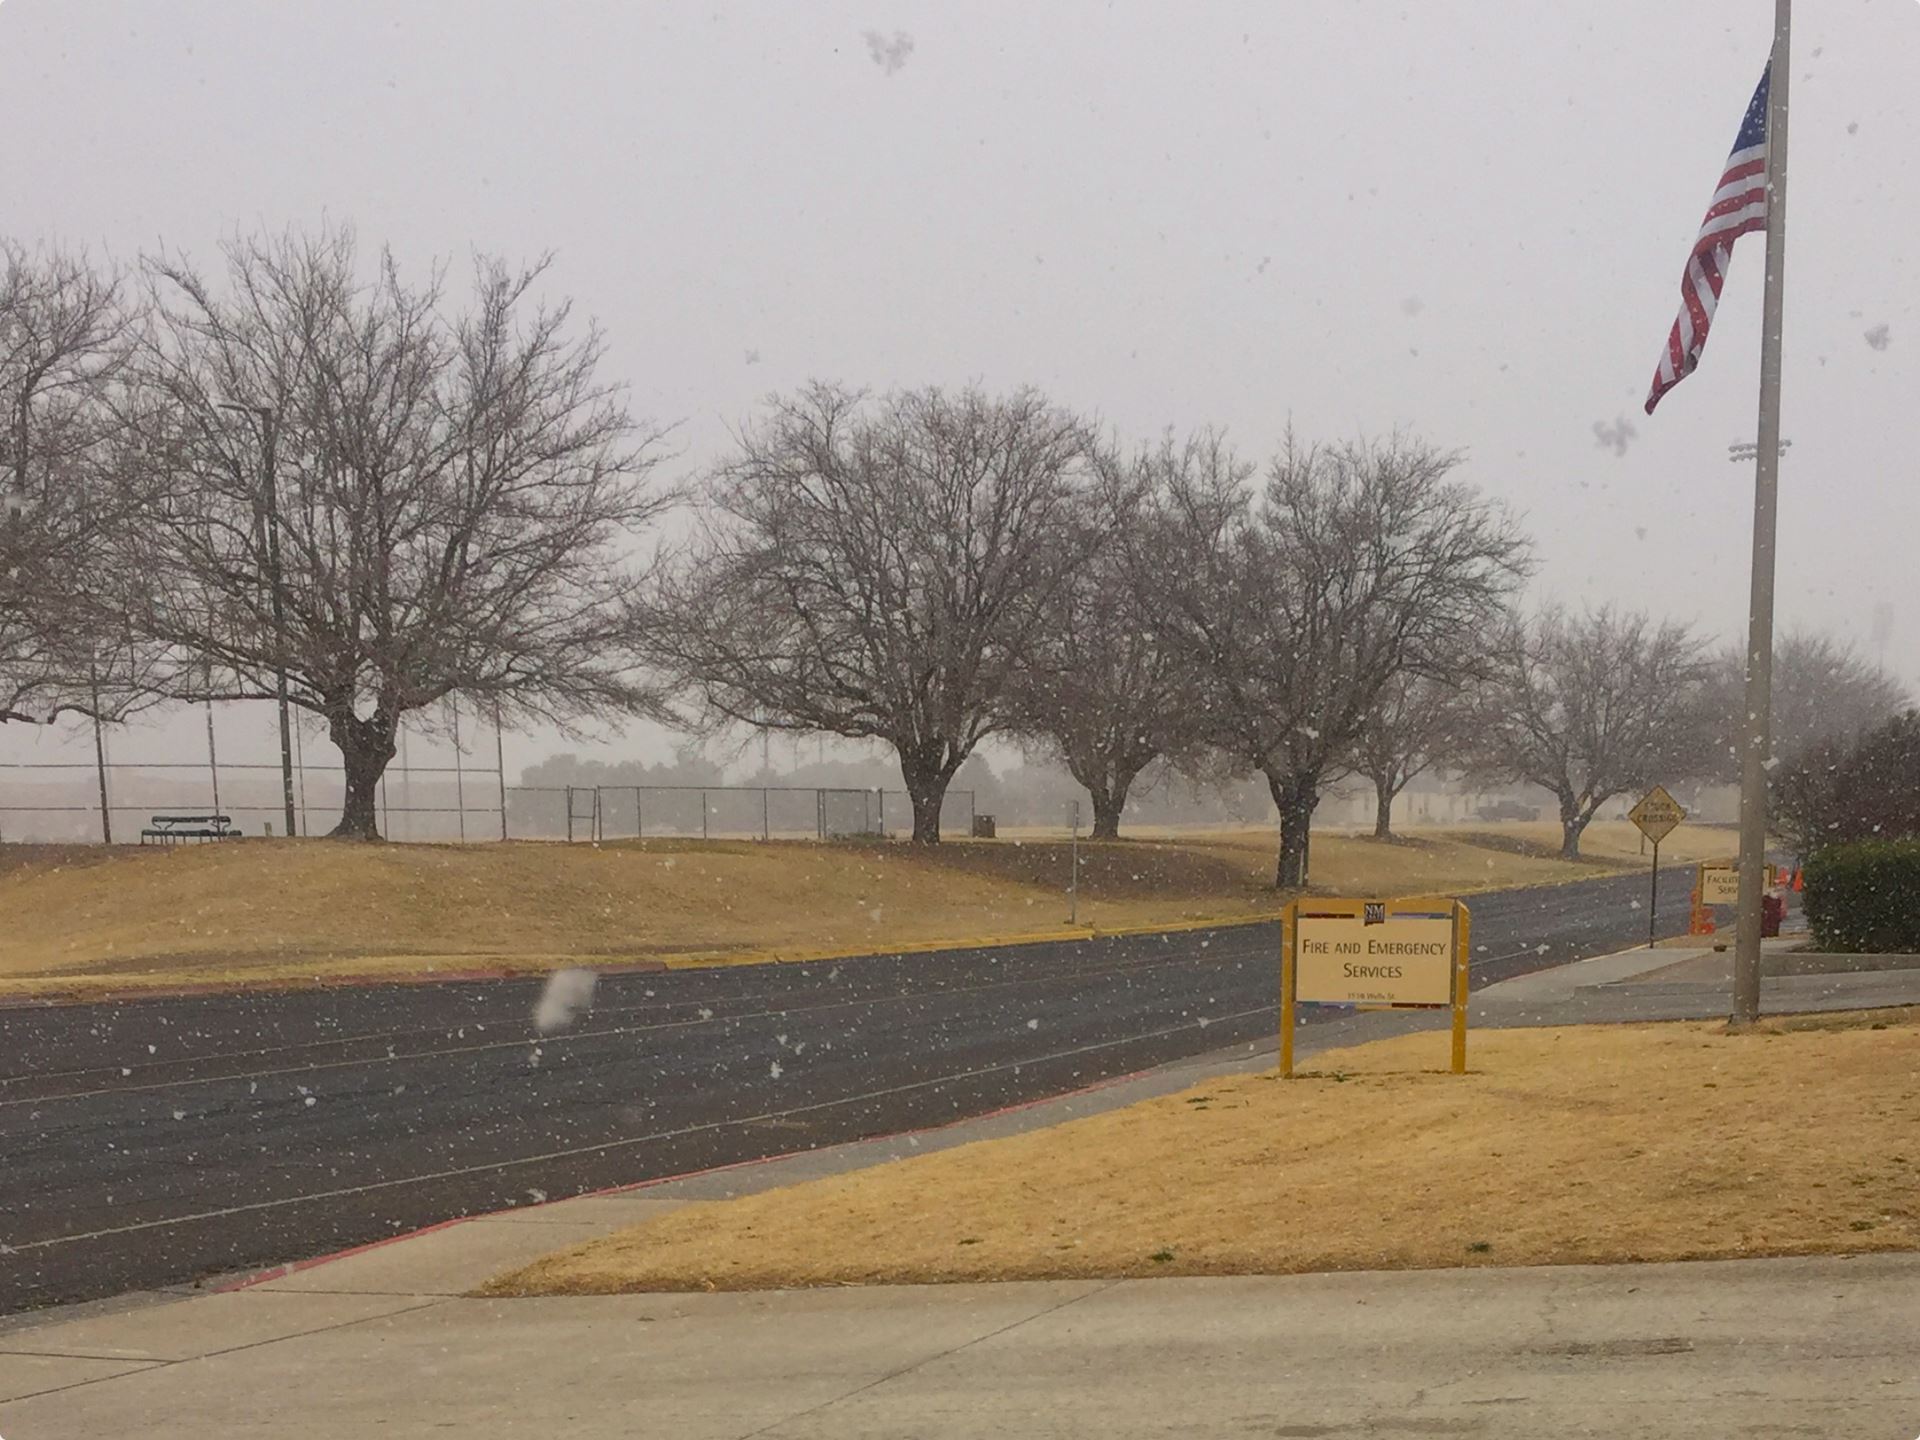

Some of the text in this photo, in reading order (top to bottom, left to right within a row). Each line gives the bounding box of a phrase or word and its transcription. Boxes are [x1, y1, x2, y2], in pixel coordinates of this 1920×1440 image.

[1302, 938, 1447, 956] FIRE AND EMERGENCY
[1343, 962, 1402, 978] SERVICES
